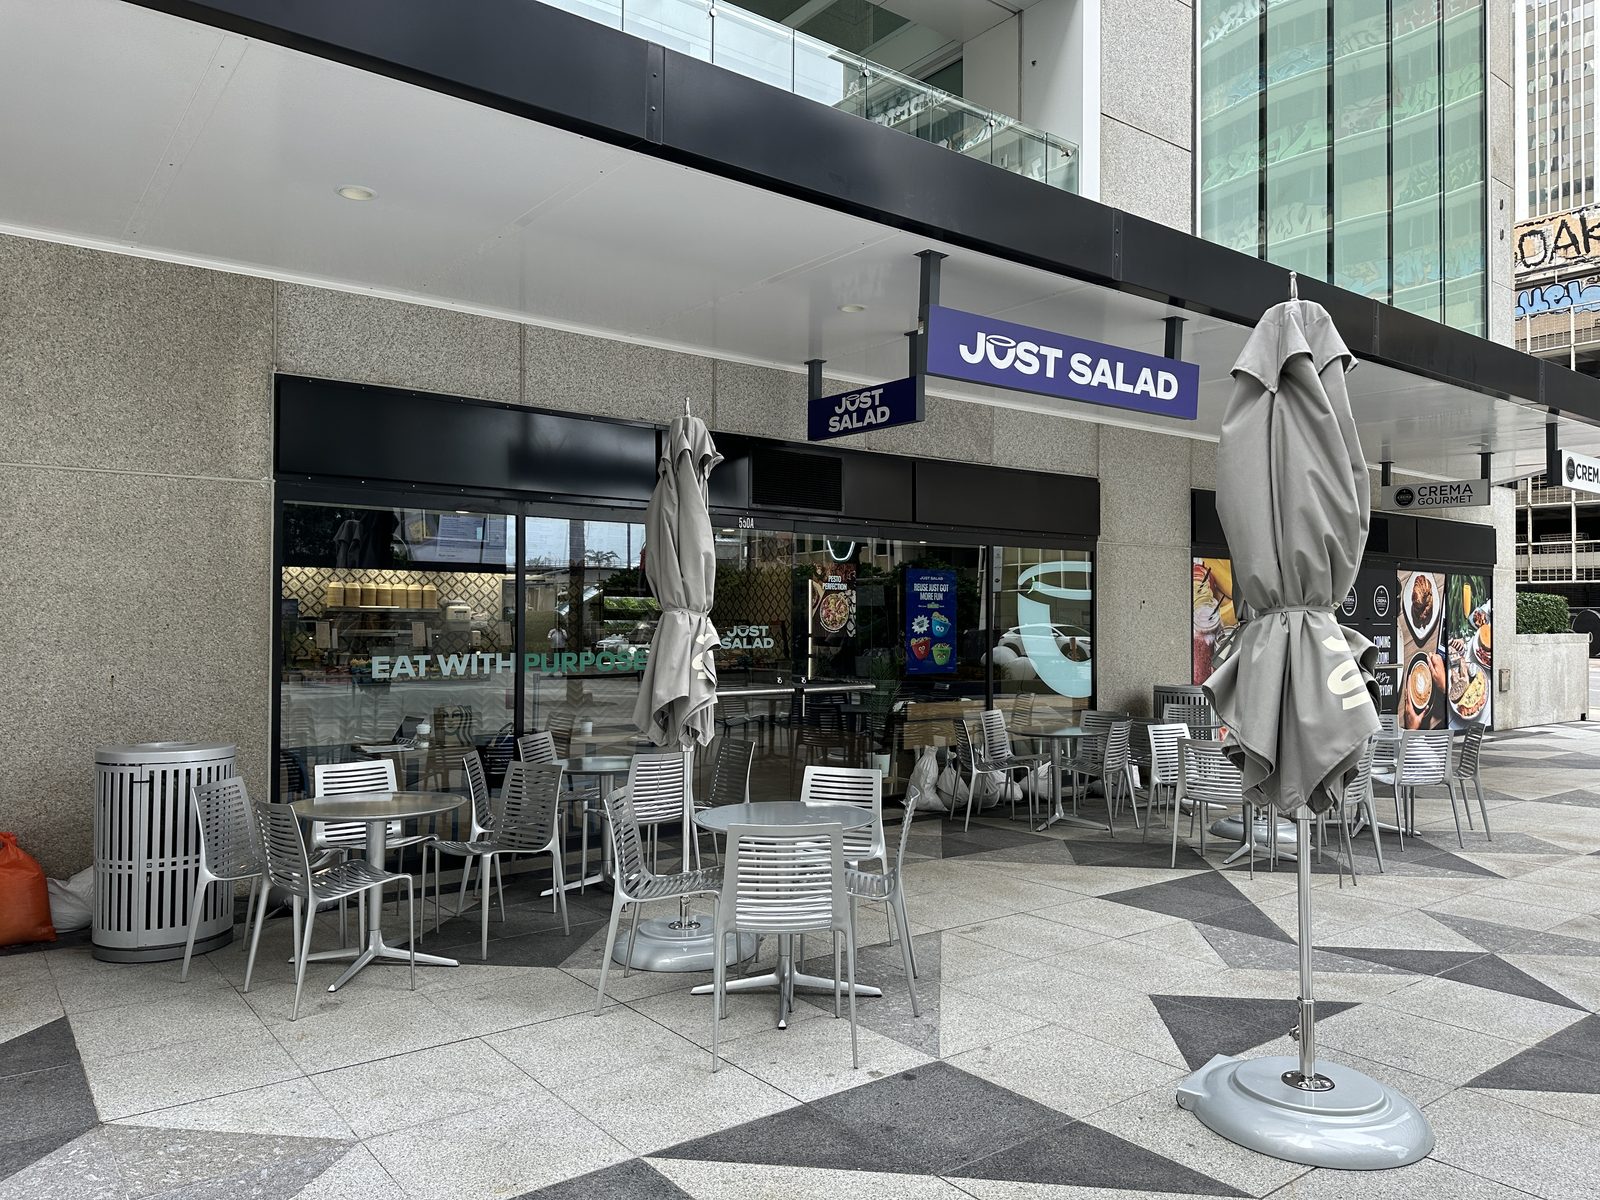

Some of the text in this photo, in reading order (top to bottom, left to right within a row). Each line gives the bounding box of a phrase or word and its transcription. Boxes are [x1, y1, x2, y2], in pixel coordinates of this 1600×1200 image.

[959, 331, 1179, 401] JUST SALAD
[834, 388, 884, 415] JUST
[828, 405, 890, 433] SALAD
[1575, 463, 1600, 484] CREM
[1417, 483, 1473, 497] CREMA
[1417, 495, 1473, 506] GOURMET
[822, 583, 848, 591] PERFECTION
[928, 583, 939, 592] JUST
[939, 584, 949, 593] GOT
[919, 592, 944, 601] MORE FUN
[726, 625, 769, 637] JUST
[720, 637, 774, 649] SALAD
[371, 650, 648, 679] EAT WITH PURPOSE
